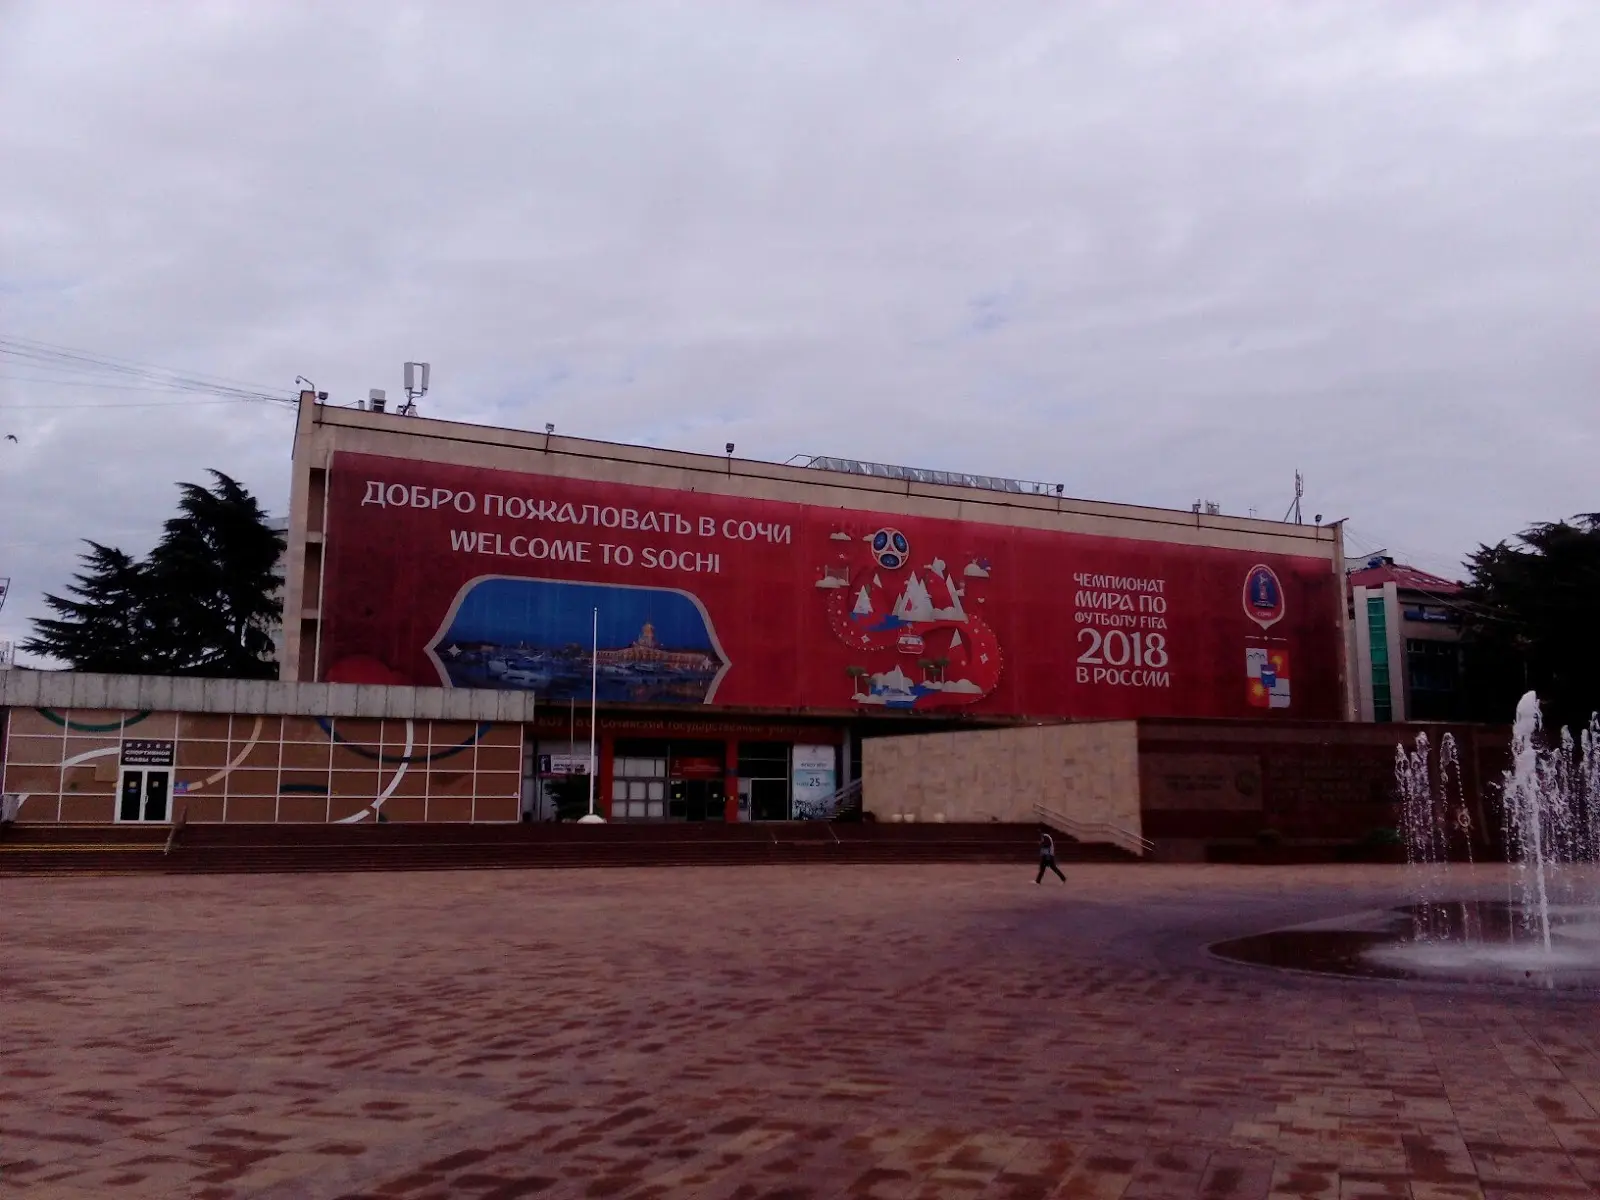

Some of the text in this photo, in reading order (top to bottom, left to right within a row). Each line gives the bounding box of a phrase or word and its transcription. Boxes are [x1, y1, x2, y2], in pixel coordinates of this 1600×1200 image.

[361, 480, 791, 544] ДОБРО ПОЖАЛОВАТЬ В СОЧИ
[450, 529, 720, 573] WELCOME TO SOCHI
[1073, 572, 1166, 593] ЧЕМПИОНАТ
[1074, 590, 1167, 614] МИРА ПО
[1074, 611, 1167, 629] ФУТБОЛУ FIFA
[1076, 628, 1169, 668] 2018
[1076, 666, 1170, 688] В РОССИИ
[809, 777, 820, 787] 25
